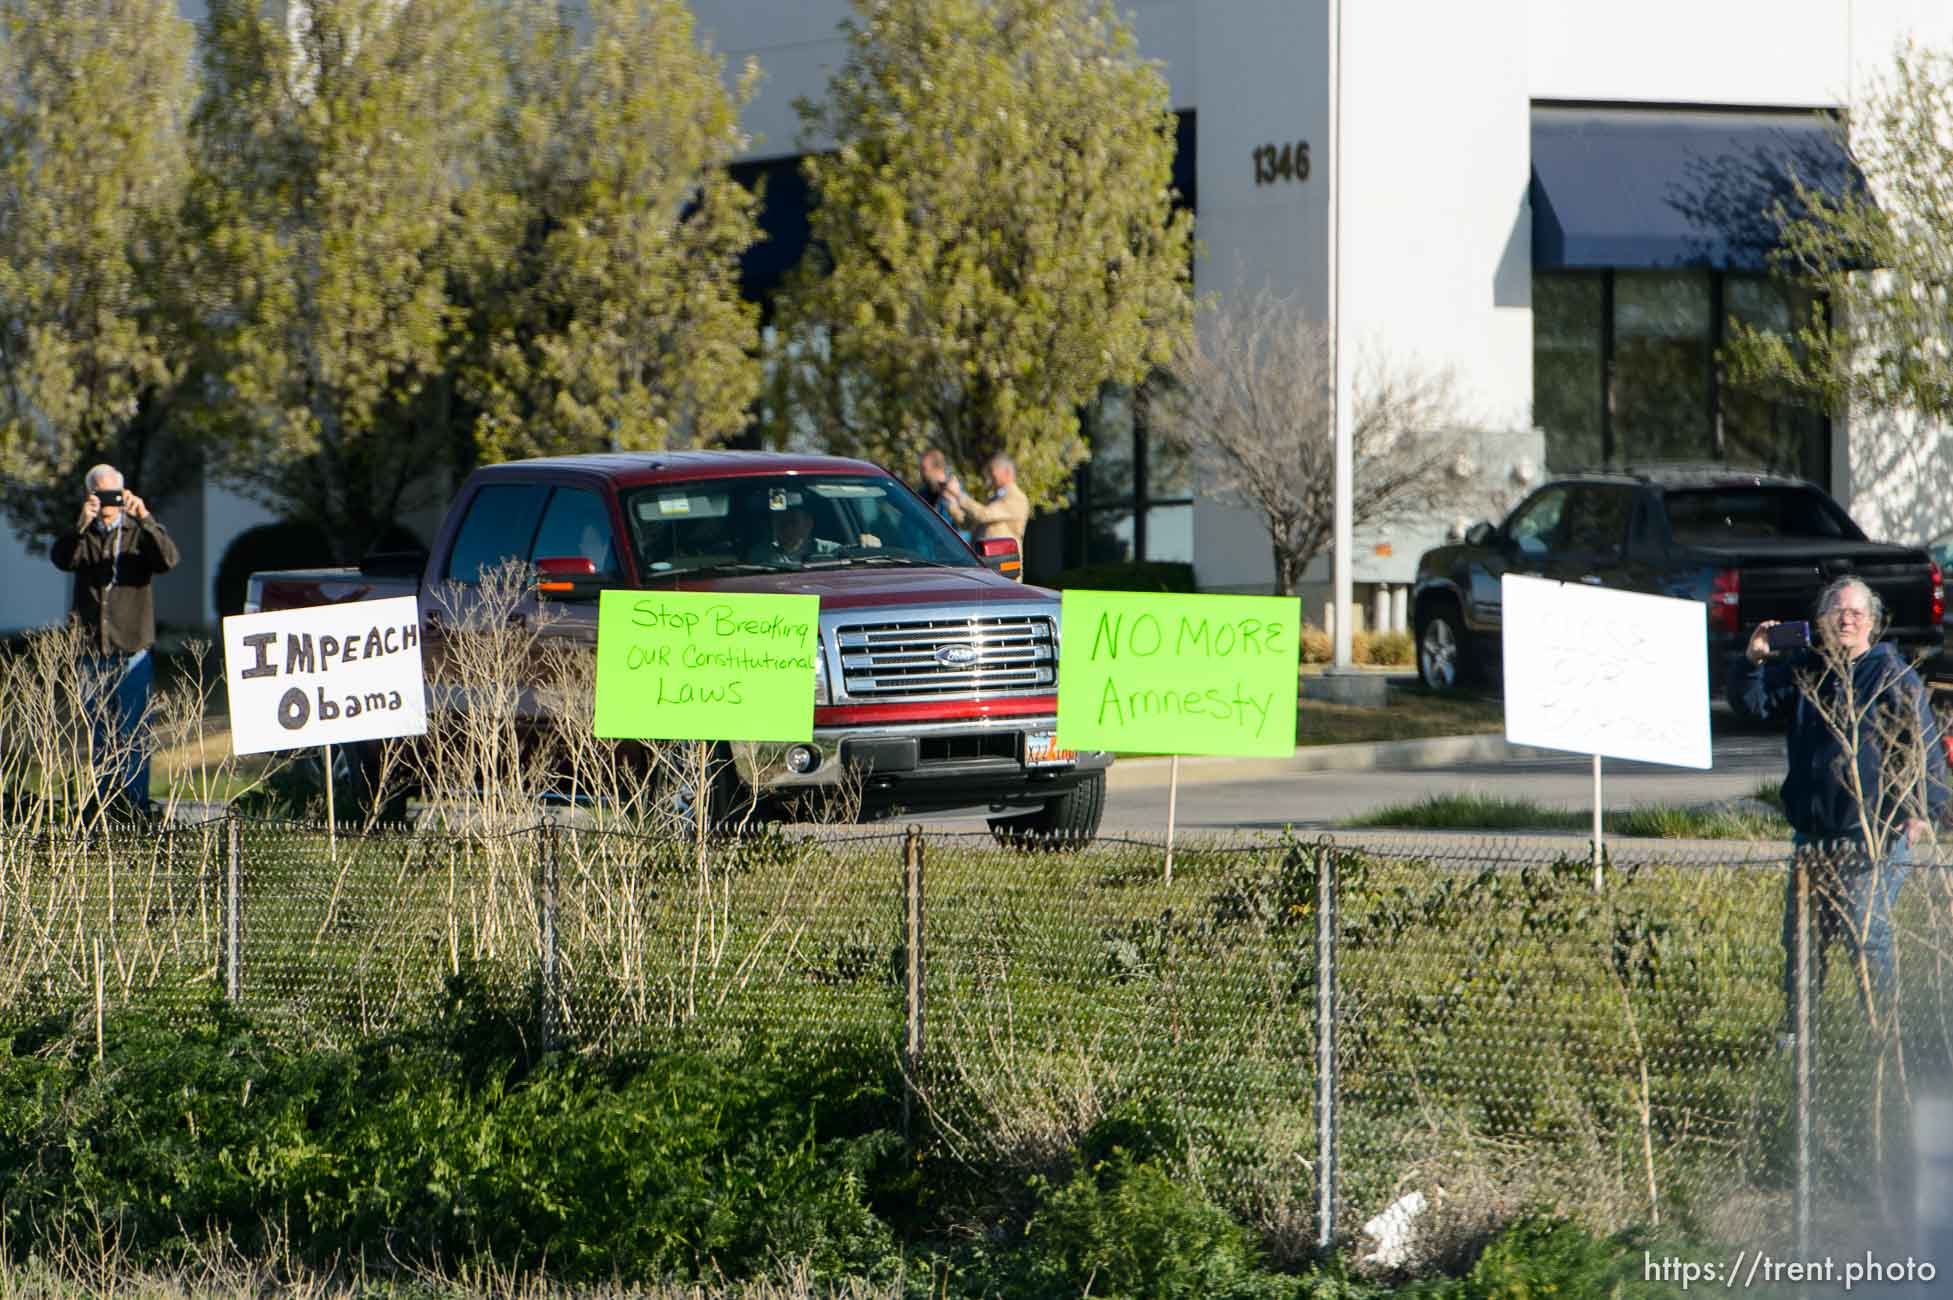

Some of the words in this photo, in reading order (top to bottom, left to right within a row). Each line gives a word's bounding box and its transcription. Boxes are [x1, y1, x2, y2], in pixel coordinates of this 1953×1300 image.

[1252, 139, 1310, 186] 1346
[632, 600, 699, 637] Stop
[706, 605, 808, 648] Breaking
[1091, 612, 1161, 661] NO
[1176, 616, 1287, 657] MORE
[241, 624, 416, 679] IMPEACH
[627, 646, 671, 670] OUR
[682, 644, 815, 670] Constitutional
[278, 687, 402, 730] Obama
[657, 677, 745, 704] Laws
[1098, 676, 1274, 738] Amnesty
